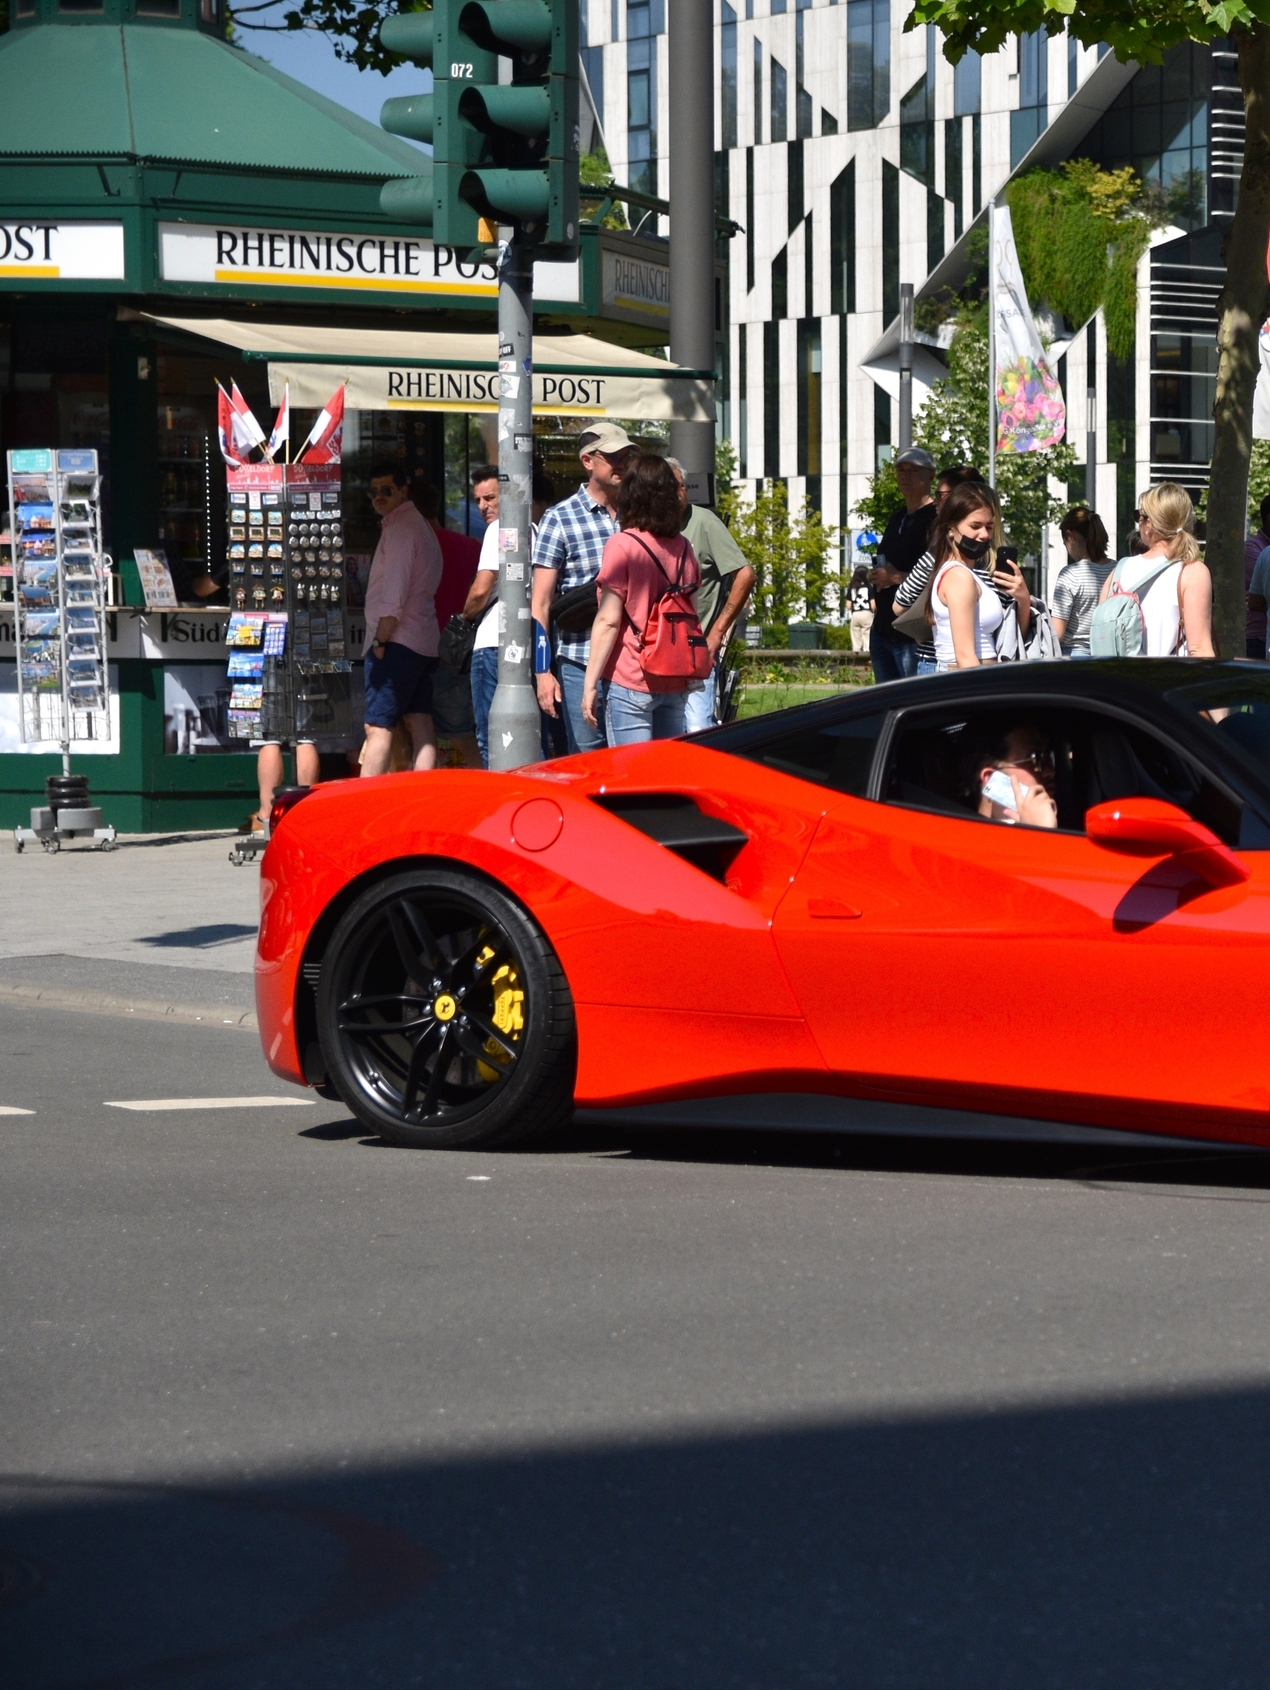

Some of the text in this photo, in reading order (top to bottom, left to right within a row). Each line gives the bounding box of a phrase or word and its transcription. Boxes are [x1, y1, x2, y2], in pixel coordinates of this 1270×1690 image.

[451, 63, 473, 78] 072
[215, 230, 420, 277] RHEINISCHE
[614, 258, 669, 303] RHEINISCH
[388, 371, 606, 405] RHEINISC POST
